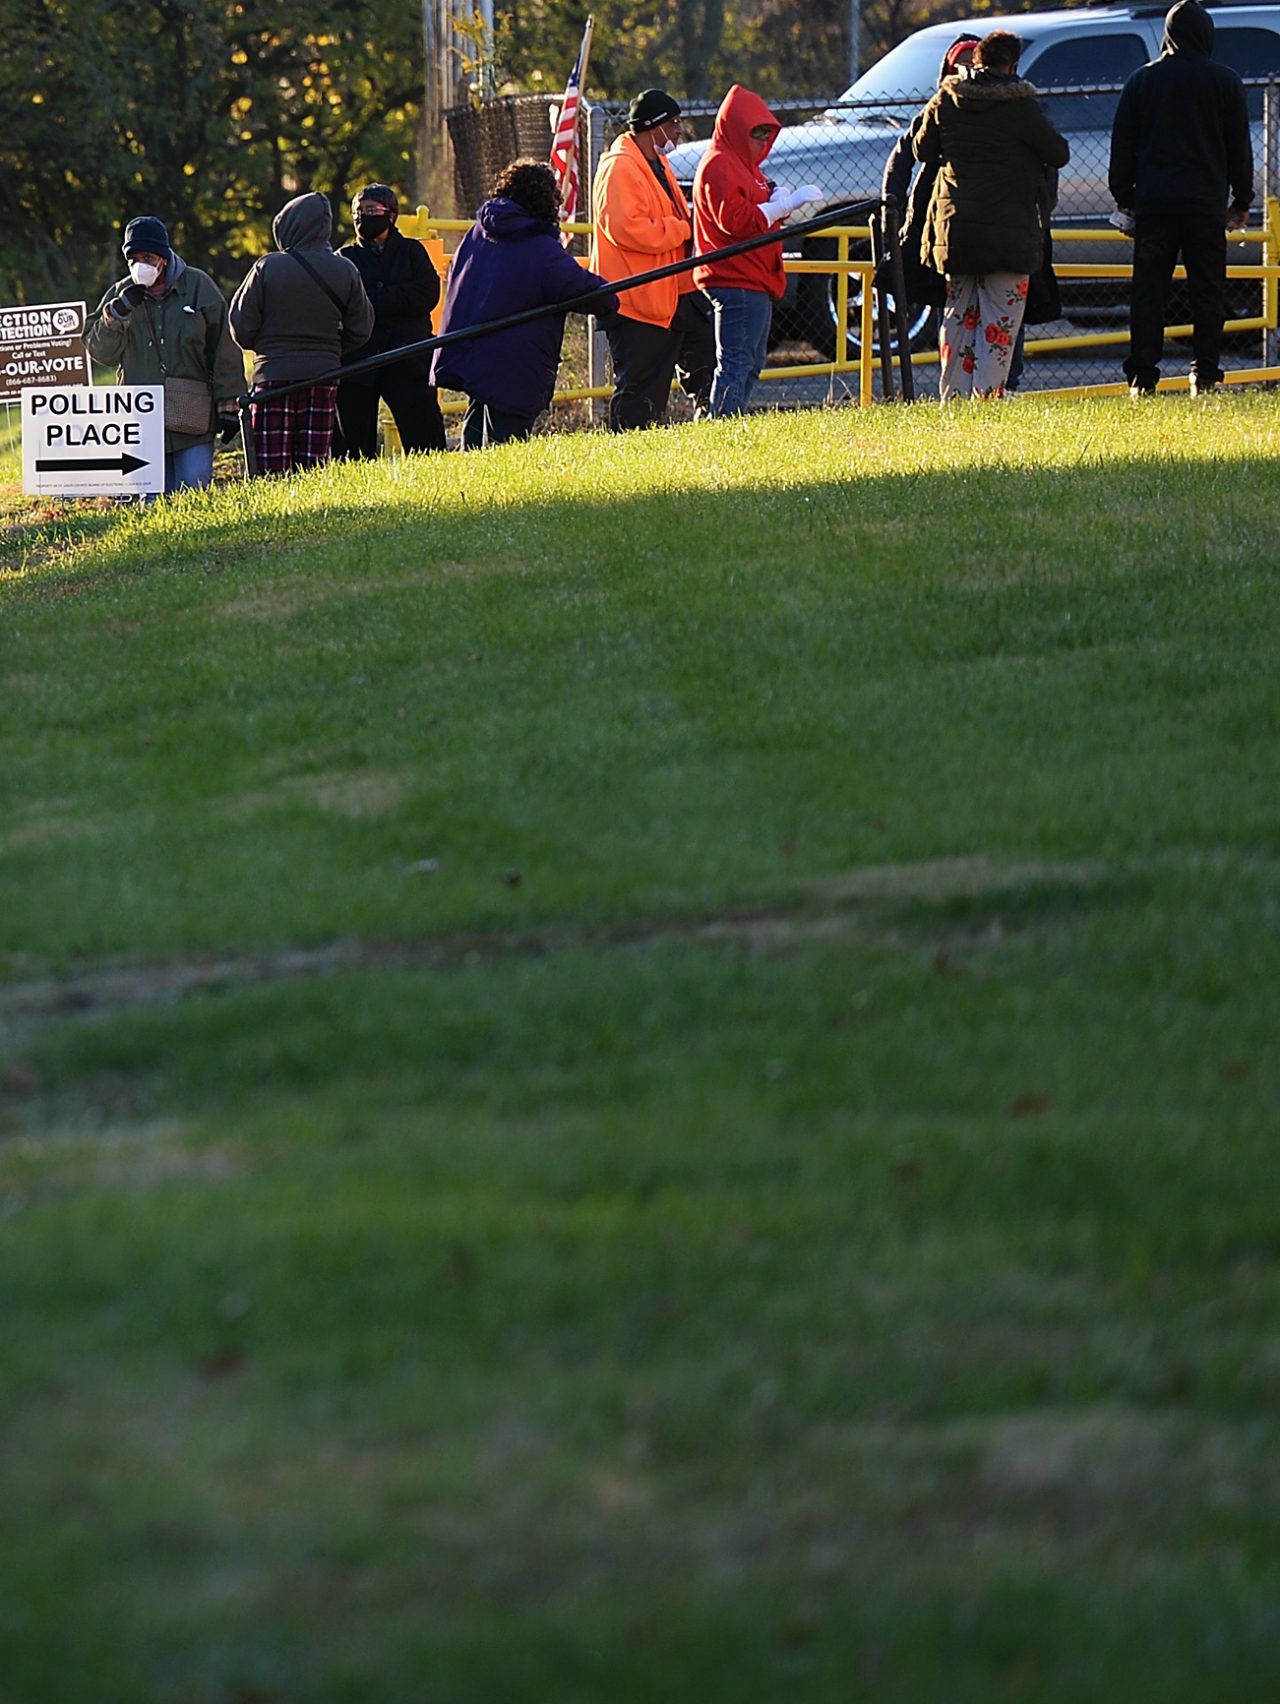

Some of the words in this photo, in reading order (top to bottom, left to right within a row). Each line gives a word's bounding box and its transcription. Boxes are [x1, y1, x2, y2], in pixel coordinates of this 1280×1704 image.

[23, 341, 51, 350] Problems
[51, 339, 72, 348] Voting?
[31, 392, 154, 416] POLLING
[47, 423, 141, 446] PLACE
